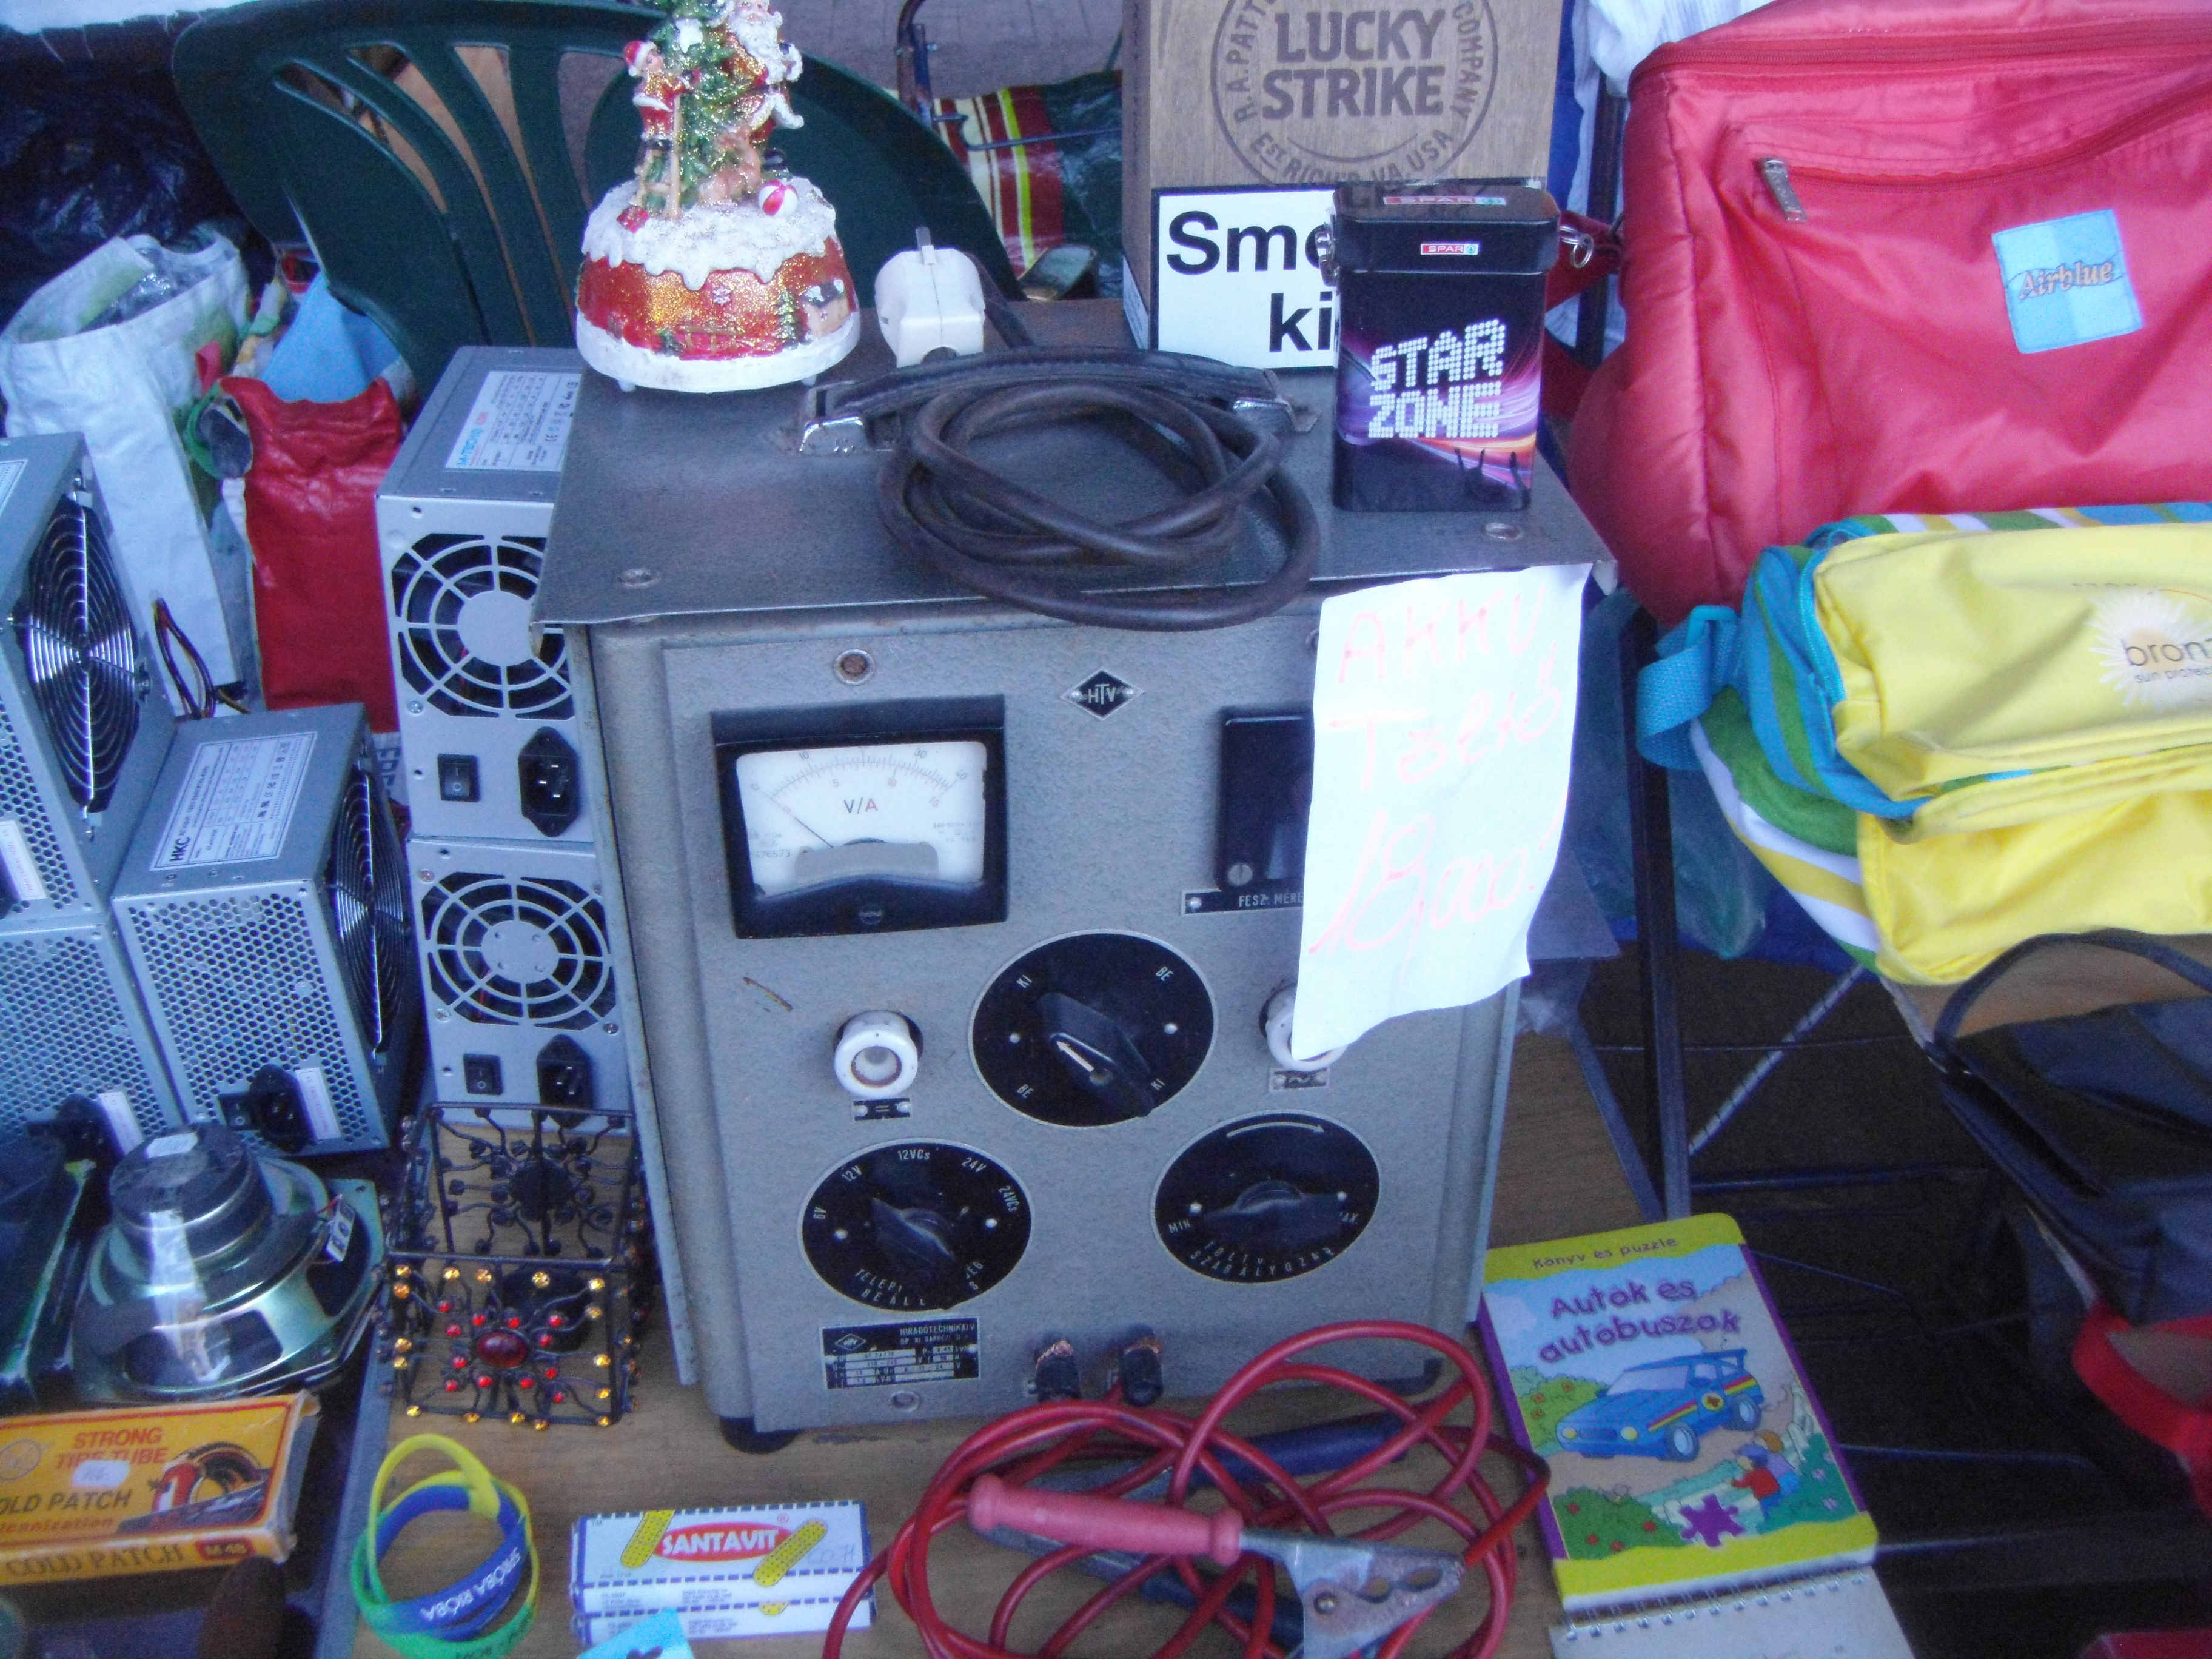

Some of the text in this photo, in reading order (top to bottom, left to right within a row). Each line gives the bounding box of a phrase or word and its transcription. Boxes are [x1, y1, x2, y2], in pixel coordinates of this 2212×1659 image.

[1275, 8, 1446, 64] LUCKY
[1262, 65, 1446, 121] STRIKE
[2018, 260, 2116, 301] Airblue
[1370, 318, 1506, 392] STAR
[1368, 381, 1503, 438] ZONE
[2120, 638, 2212, 666] bron
[1088, 683, 1116, 705] HTV
[842, 1165, 863, 1182] 12V
[961, 1157, 987, 1173] 24V
[73, 1427, 163, 1449] STRONG
[47, 1489, 133, 1511] PATCH
[662, 1528, 780, 1555] SANTAVIT
